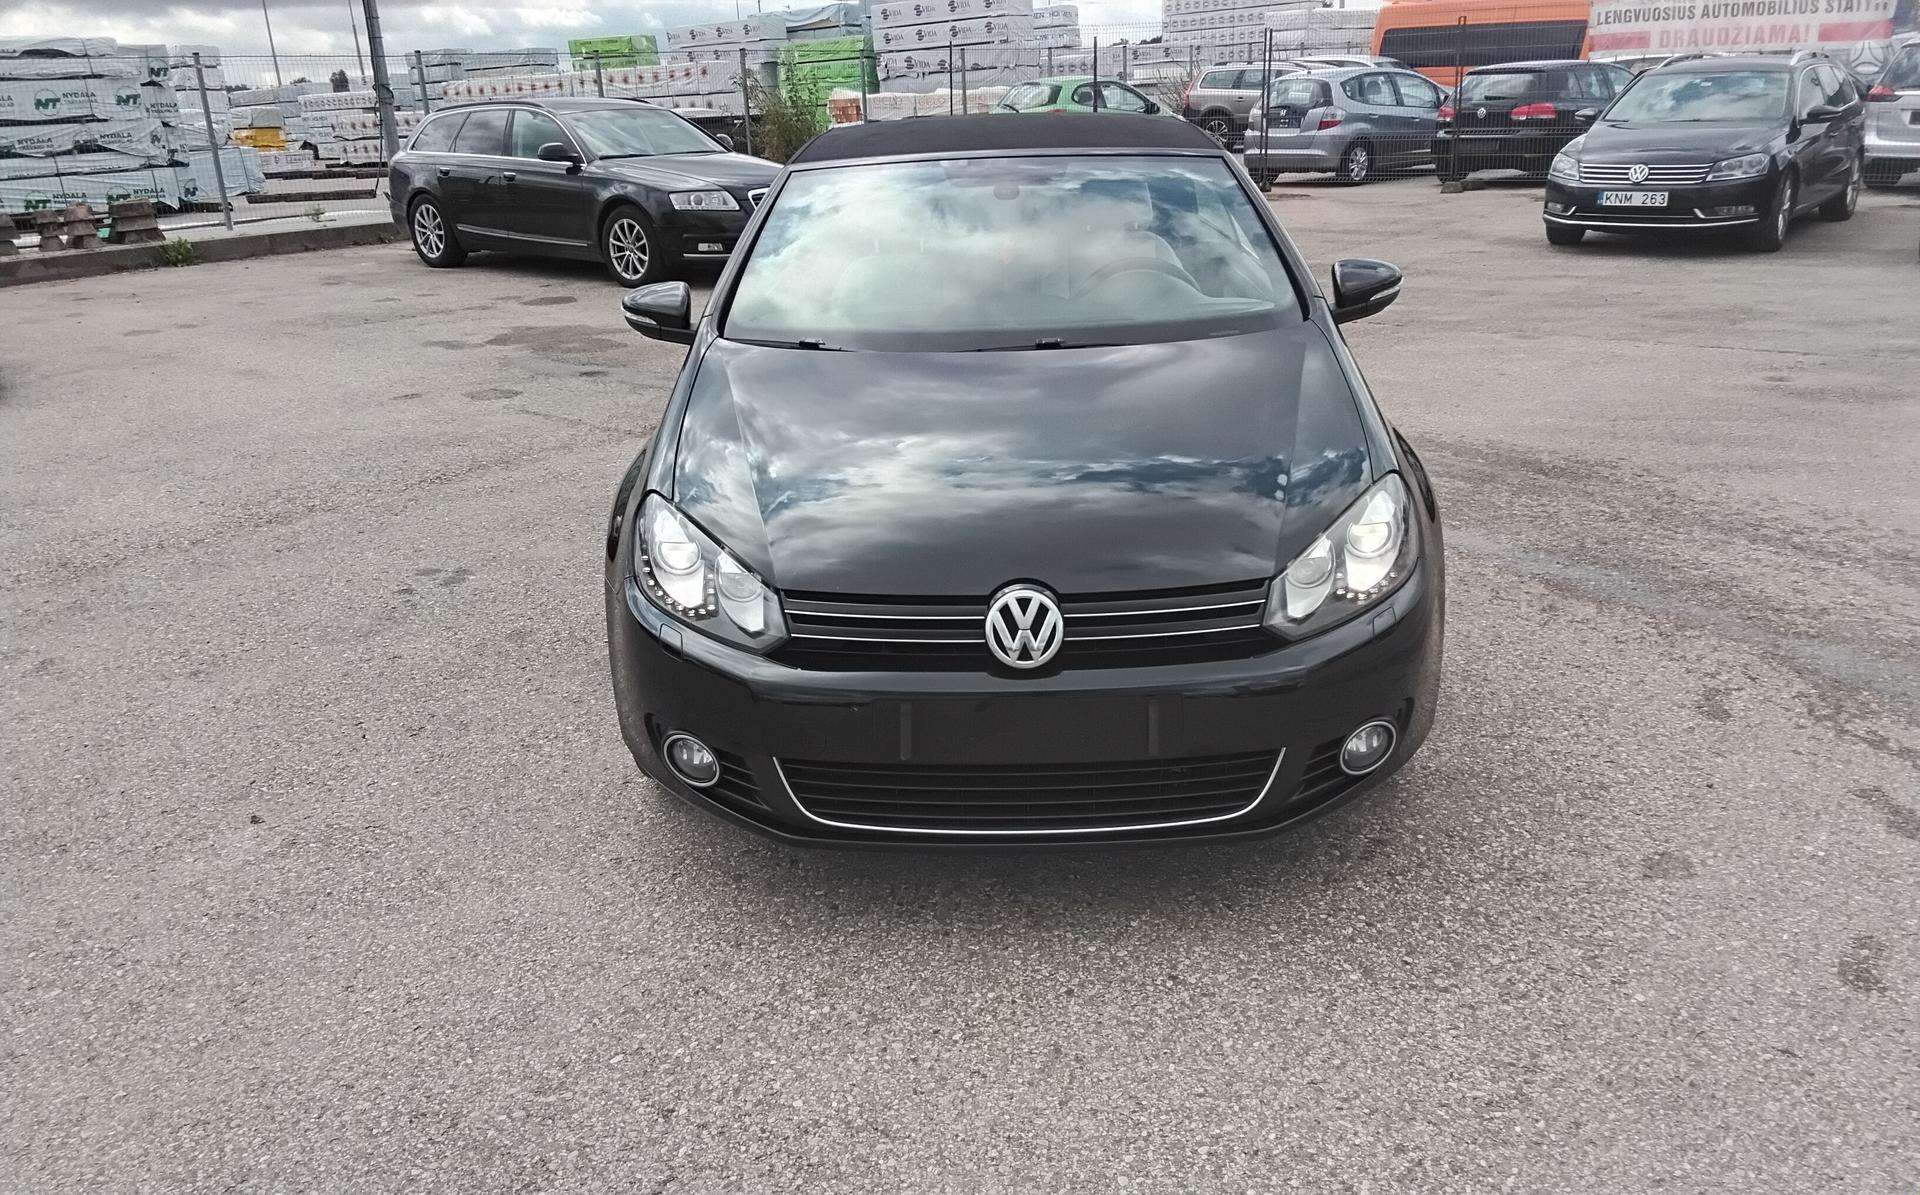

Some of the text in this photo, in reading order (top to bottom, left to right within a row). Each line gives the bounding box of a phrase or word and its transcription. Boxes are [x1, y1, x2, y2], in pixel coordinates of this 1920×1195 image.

[1597, 5, 1696, 25] LENGVUOSIUS
[1700, 0, 1819, 19] AUTOMOBILIUS
[132, 187, 165, 195] NYDALA
[1604, 193, 1633, 205] KNM
[1641, 194, 1666, 205] 263
